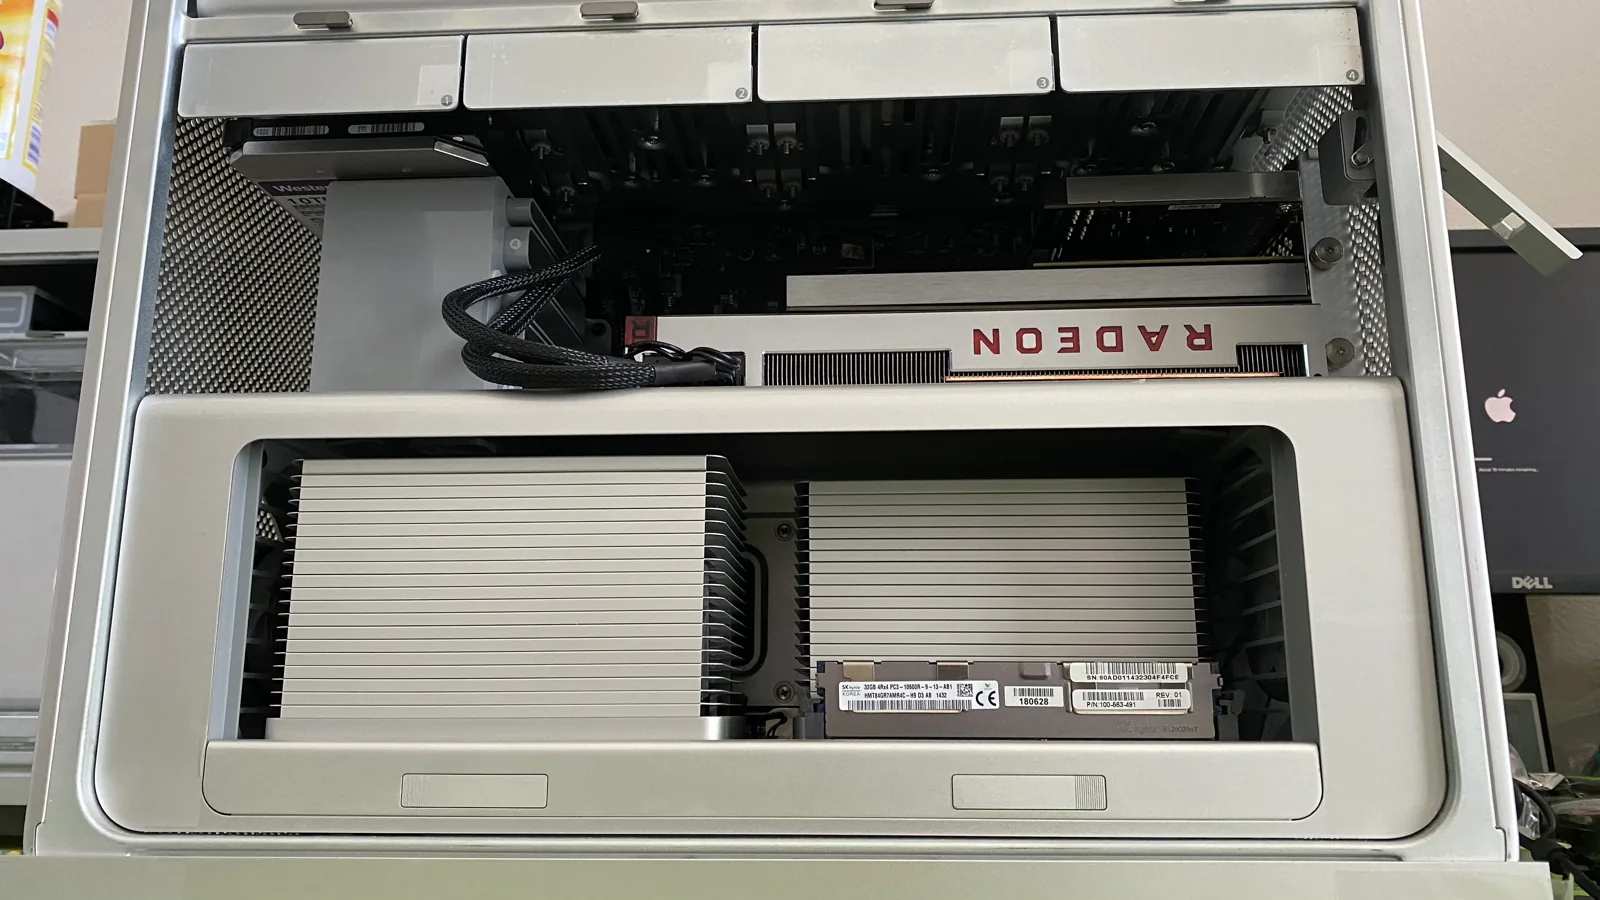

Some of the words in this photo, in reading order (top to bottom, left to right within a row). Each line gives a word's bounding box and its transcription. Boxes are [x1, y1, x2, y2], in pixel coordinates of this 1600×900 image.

[973, 324, 1213, 355] RADEON
[1511, 575, 1553, 590] DELL
[863, 683, 876, 691] 32GB
[1019, 697, 1049, 706] 180628
